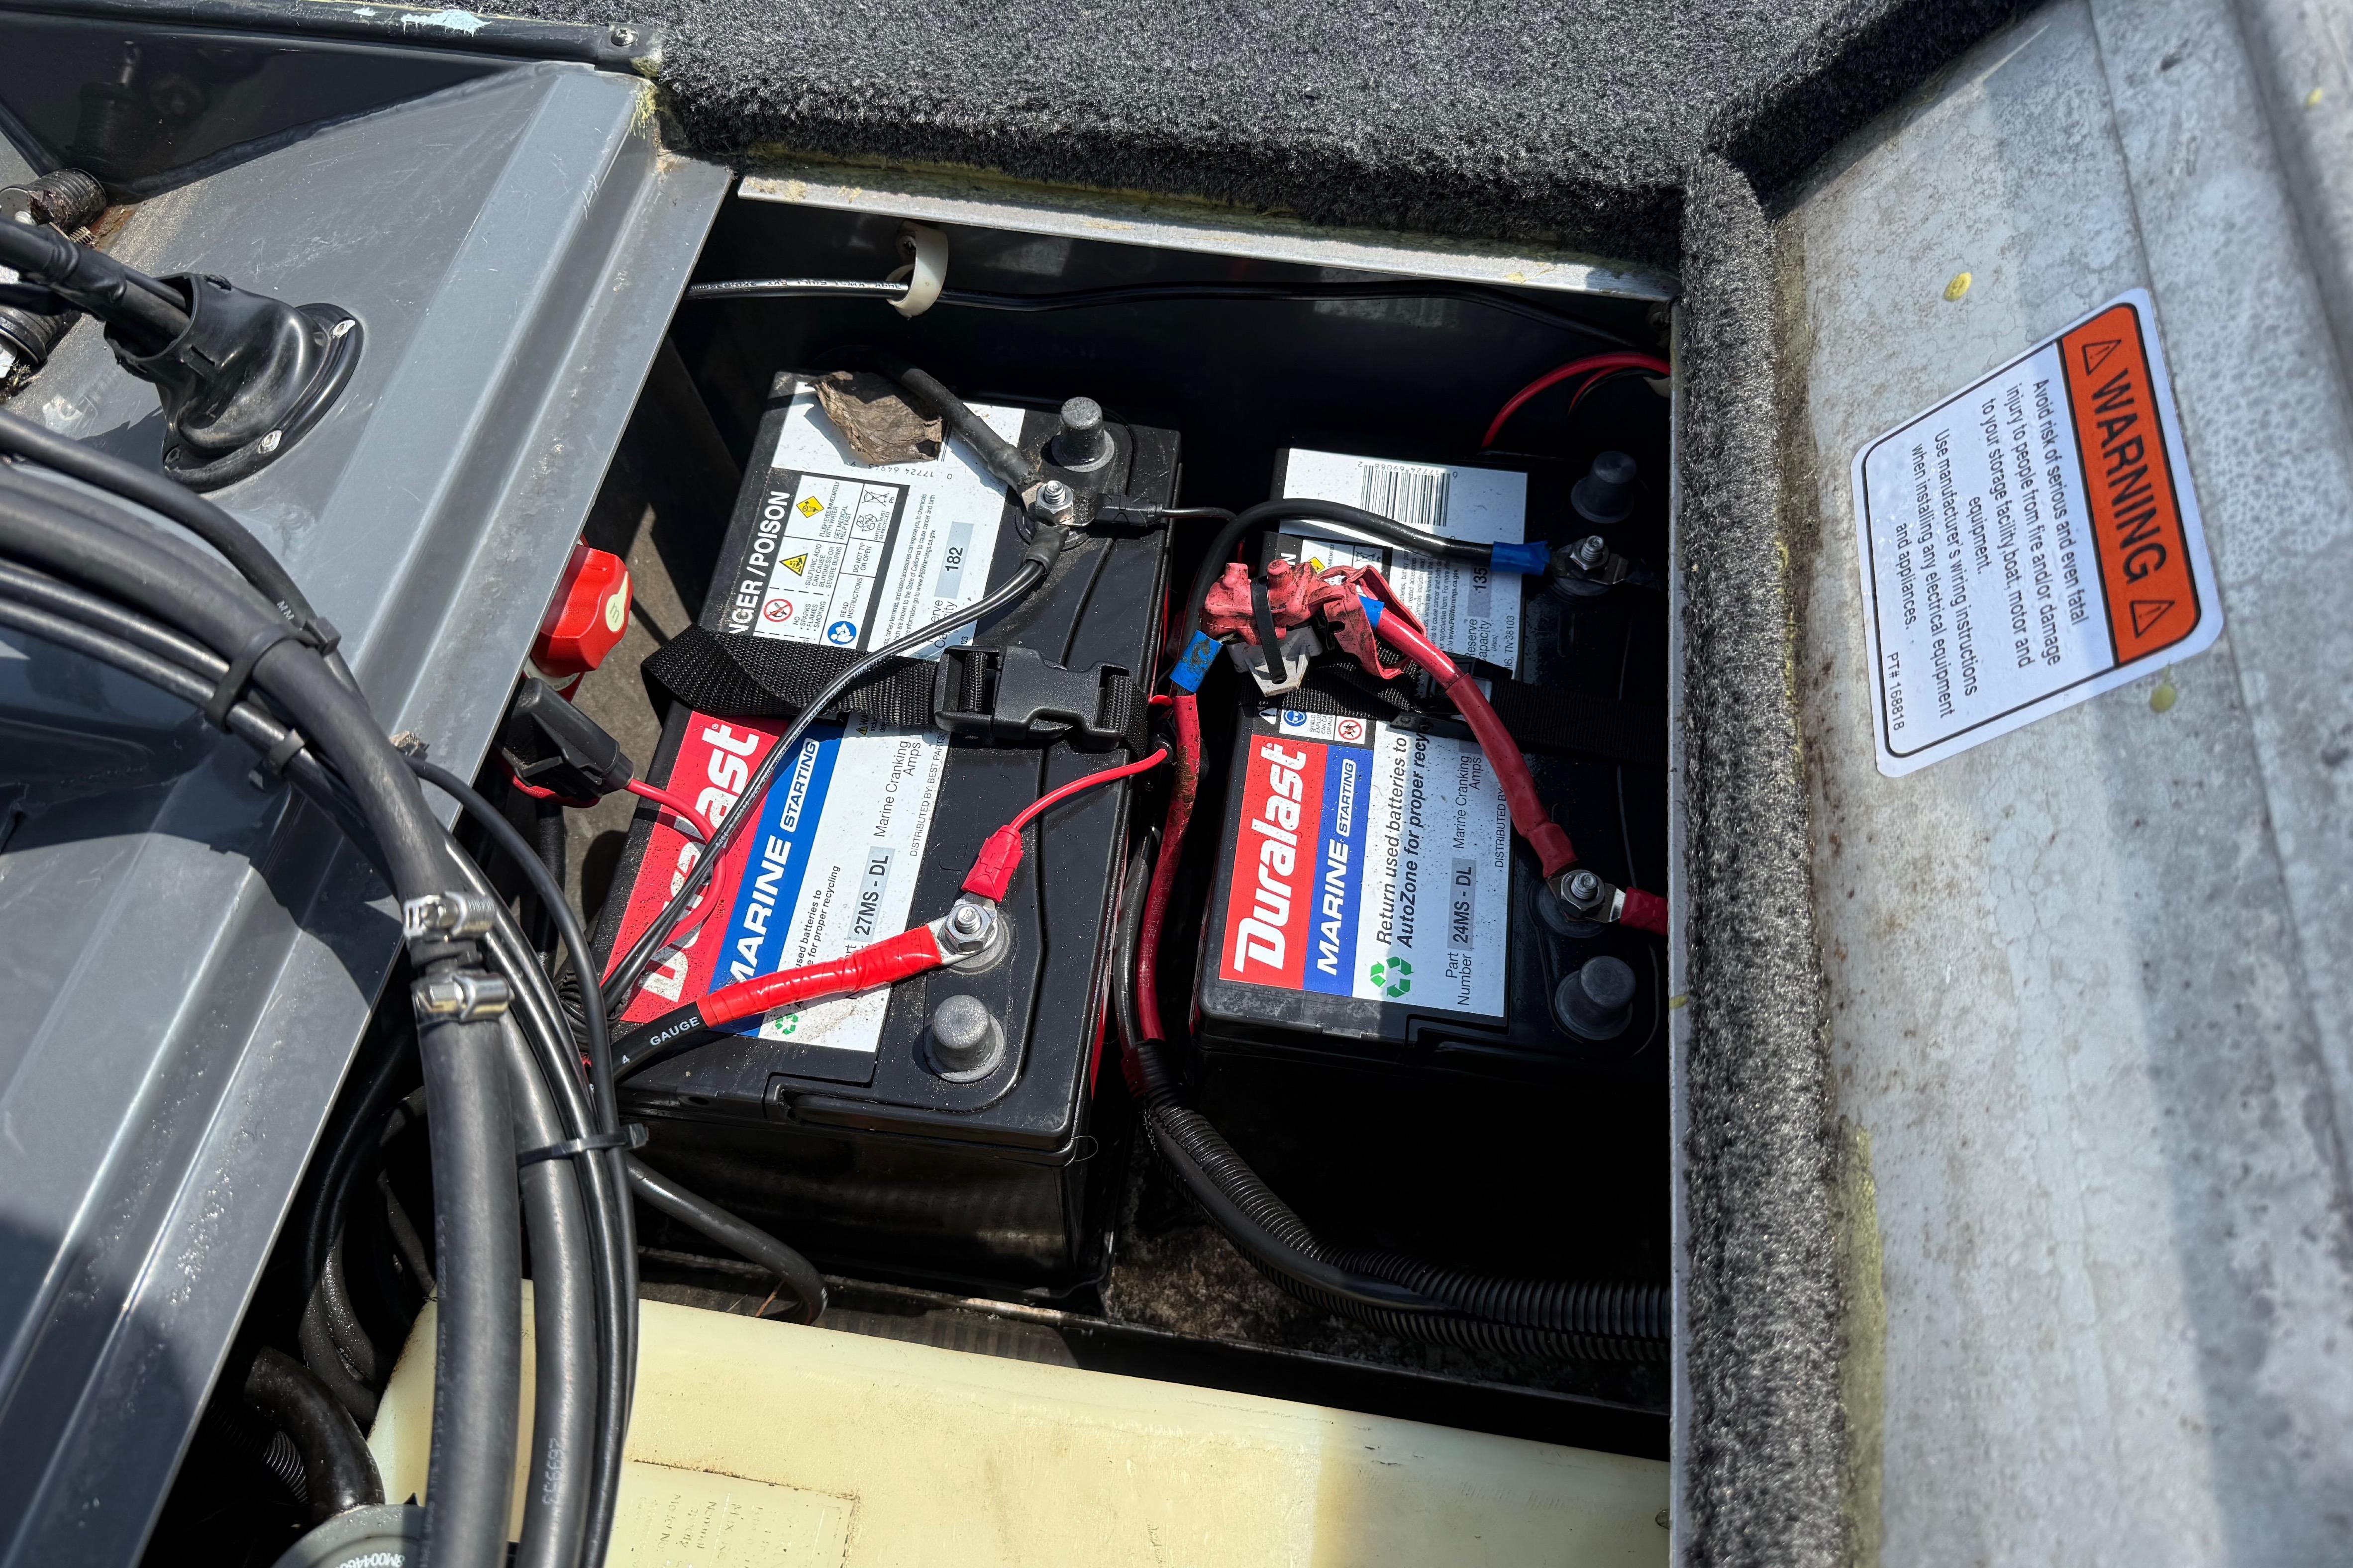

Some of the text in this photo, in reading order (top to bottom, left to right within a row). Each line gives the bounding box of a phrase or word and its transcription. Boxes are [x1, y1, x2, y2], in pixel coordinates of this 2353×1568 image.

[1982, 397, 1996, 415] to
[1979, 414, 2000, 446] your
[905, 468, 934, 478] 17724
[1375, 463, 1405, 472] 69088
[1411, 467, 1439, 476] 17724
[1988, 448, 2007, 501] storage
[2091, 368, 2167, 585] WARNING
[828, 506, 839, 524] WATER
[836, 505, 848, 528] MEDICAL
[843, 512, 851, 526] FAST
[2033, 379, 2089, 625] Avoid risk of serious and even fatal
[1966, 496, 1992, 575] equipment.
[2004, 382, 2061, 666] injury to people from fire and/or damage
[805, 544, 822, 586] SULFURIC ACID
[812, 555, 826, 587] CAN CAUSE
[818, 547, 835, 588] BLINDNESS OR
[825, 547, 842, 588] SEVERE BURNS
[852, 564, 859, 573] DO
[860, 546, 872, 571] OR OPEN
[945, 547, 963, 572] 182
[1896, 523, 1917, 630] and appliances.
[1935, 428, 1978, 696] Use manufacturer's wiring instructions
[847, 577, 863, 619] INSTRUCTIONS
[1472, 567, 1488, 592] 135
[1912, 443, 1955, 719] when installing any electrical equipment
[793, 616, 800, 625] NO
[800, 603, 811, 626] SPARKS
[807, 604, 818, 627] FLAMES
[813, 601, 826, 628] SMOKING
[839, 602, 849, 618] READ
[1447, 568, 1461, 640] www.P65Warnings.ca.gov.
[2008, 589, 2028, 634] motor
[1438, 610, 1448, 642] reproductive
[1505, 615, 1516, 654] TN 38103
[2015, 638, 2035, 669] and
[1887, 652, 1905, 731] PT# 168818
[903, 742, 921, 777] Amps
[927, 762, 938, 784] BEST
[1468, 756, 1482, 790] Amps
[783, 741, 817, 829] STARTING
[873, 741, 912, 837] Marine Cranking
[923, 786, 933, 799] BY:
[1407, 770, 1428, 828] proper
[1453, 755, 1472, 850] Marine Cranking
[910, 800, 931, 857] DISTRIBUTED
[1376, 737, 1408, 946] Return used batteries to
[1403, 831, 1421, 857] for
[1495, 803, 1507, 869] DISTRIBUTED
[1233, 742, 1307, 974] Duralast
[1317, 762, 1354, 976] MARINE STARTING
[808, 942, 818, 957] for
[814, 908, 827, 942] proper
[822, 866, 841, 907] recycling
[854, 855, 889, 936] 27MS DL
[1396, 859, 1419, 949] AutoZone
[1453, 865, 1472, 944] 24MS DL
[800, 902, 818, 944] batteries
[813, 890, 821, 899] to
[1445, 951, 1460, 979] Part
[1457, 953, 1474, 1007] Number
[650, 1016, 700, 1046] GAUGE
